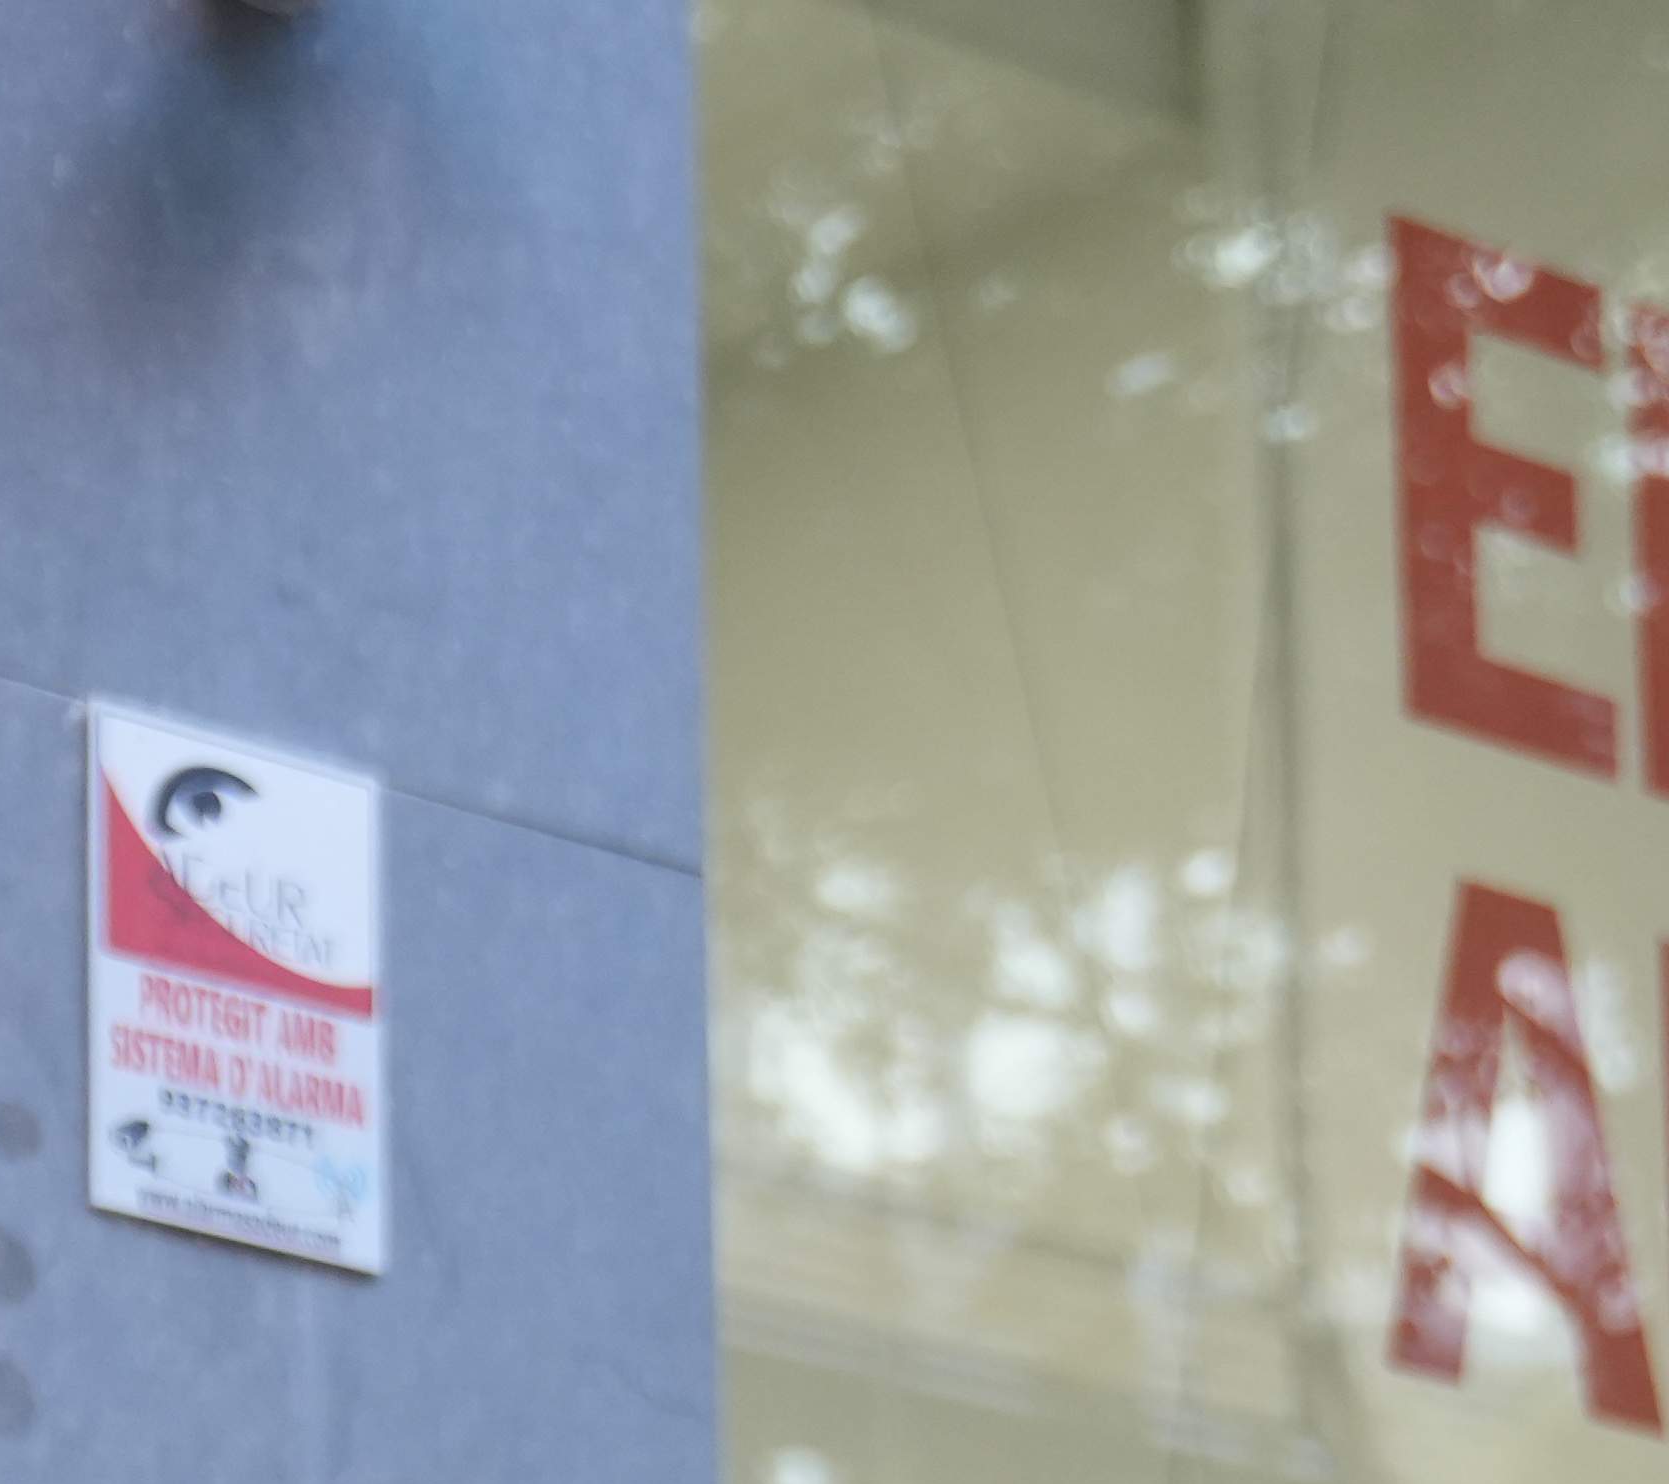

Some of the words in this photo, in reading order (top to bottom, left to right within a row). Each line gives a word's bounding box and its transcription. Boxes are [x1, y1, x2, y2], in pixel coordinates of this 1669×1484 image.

[110, 1023, 220, 1088] SISTEMA
[139, 971, 268, 1044] PROTEGIT
[279, 1008, 336, 1066] AMB
